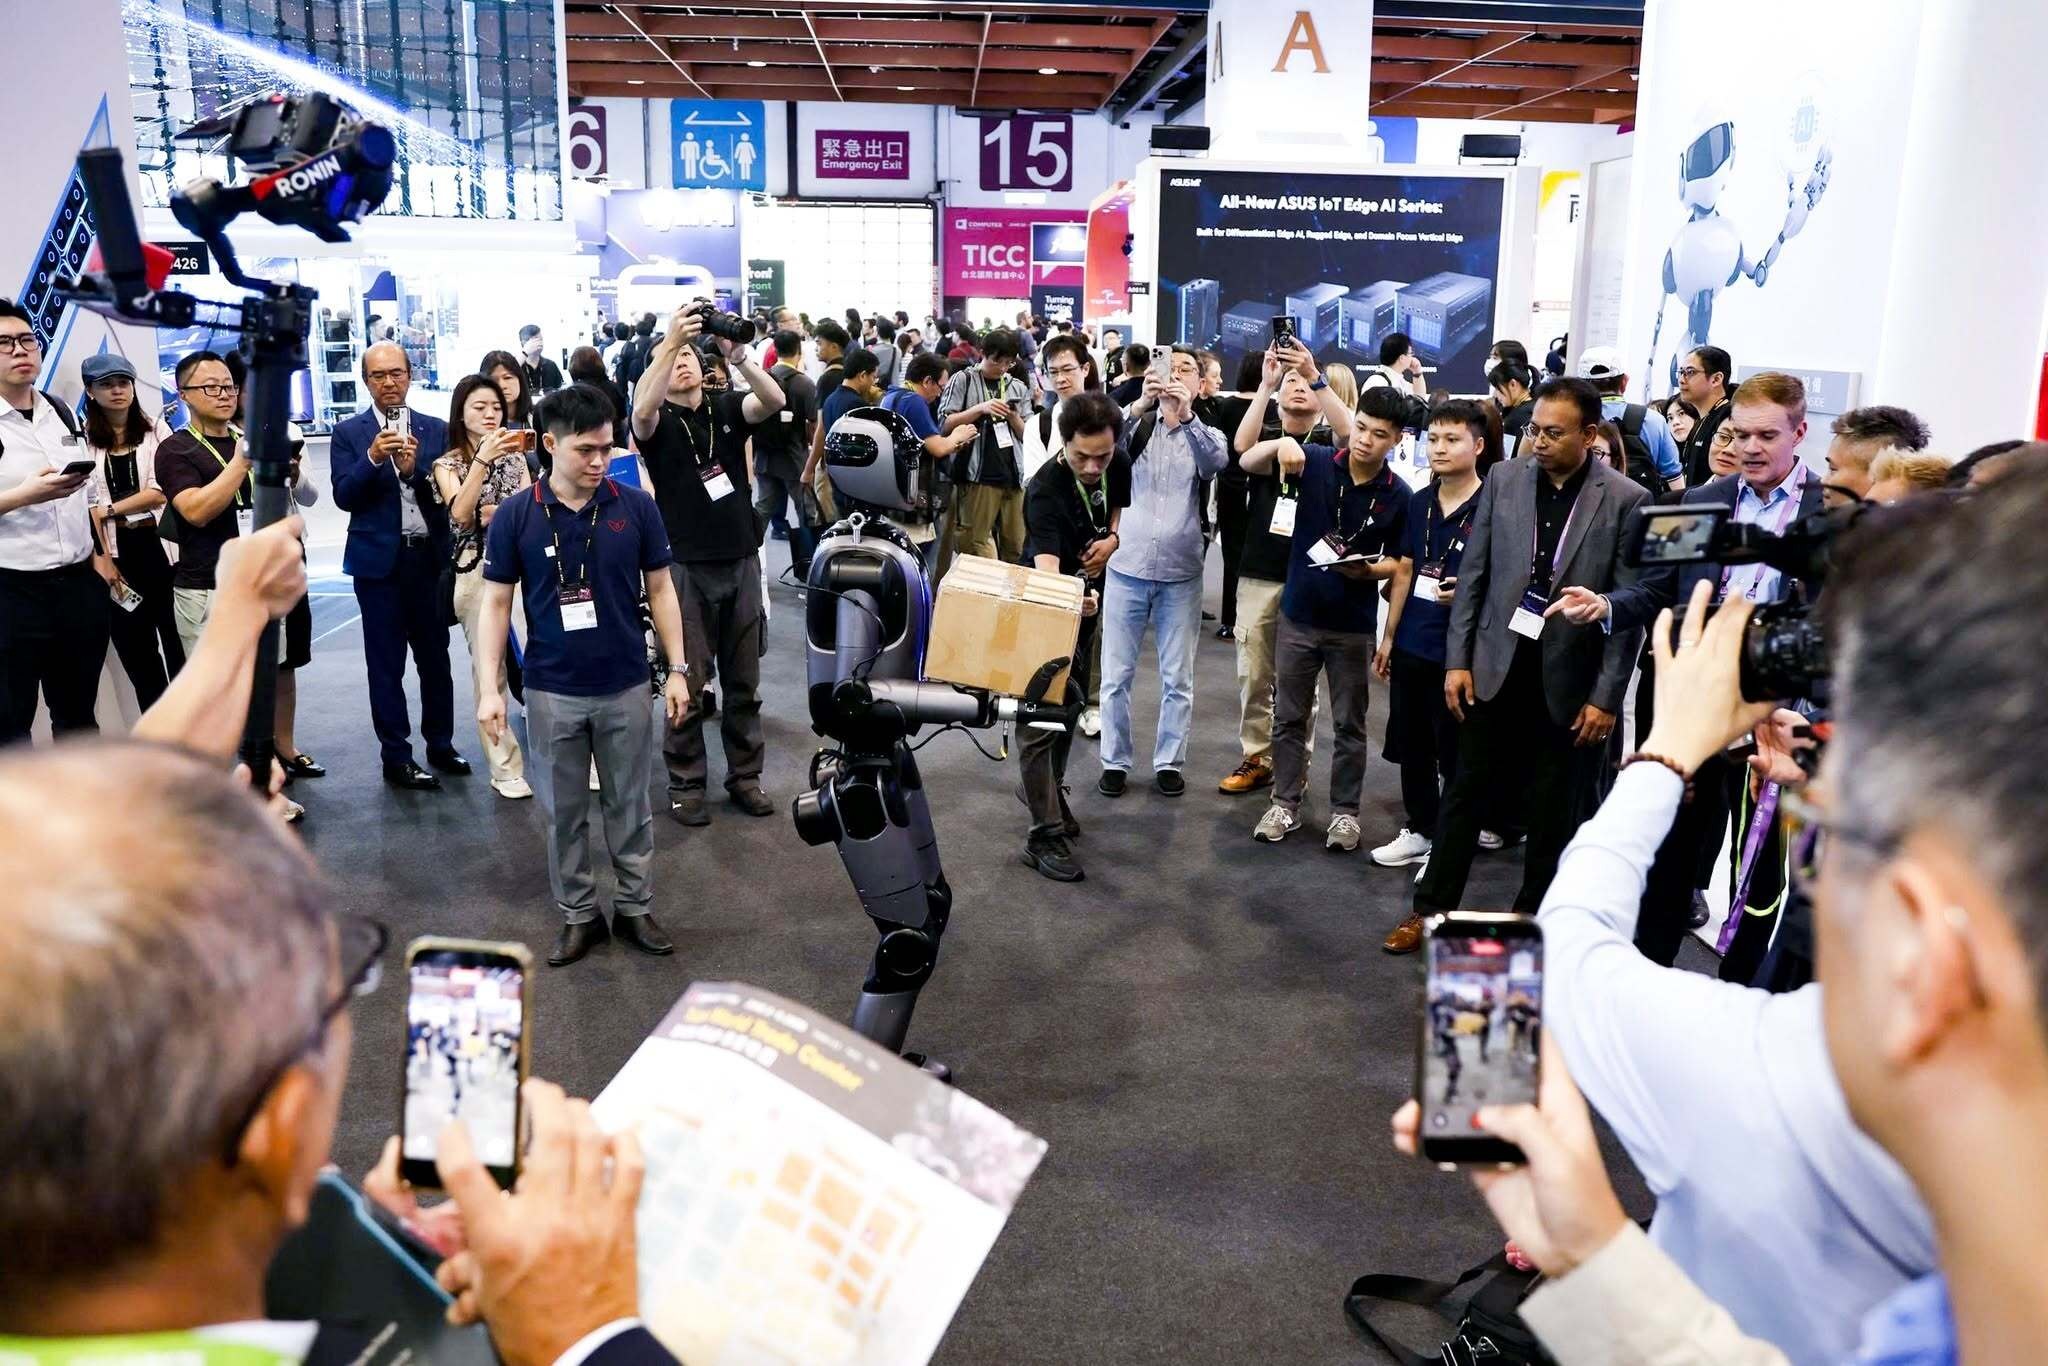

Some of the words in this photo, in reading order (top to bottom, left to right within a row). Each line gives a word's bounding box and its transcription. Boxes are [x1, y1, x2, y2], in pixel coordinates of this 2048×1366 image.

[1271, 10, 1331, 74] A
[569, 111, 602, 177] 6
[822, 138, 903, 159] 緊急出口
[984, 119, 1068, 187] 15
[822, 159, 879, 171] Emergency
[882, 160, 903, 170] Exit
[275, 155, 341, 198] RONIN
[1219, 195, 1277, 209] All-New
[1277, 196, 1317, 210] ASUS
[1319, 197, 1342, 211] IoT
[1343, 197, 1379, 215] Edge
[1380, 199, 1396, 212] AI
[1398, 199, 1443, 214] Series:
[1196, 228, 1213, 236] Built
[1214, 228, 1225, 236] for
[1277, 229, 1294, 239] Edge
[1306, 230, 1333, 240] Rugged
[1354, 231, 1367, 240] and
[1418, 232, 1445, 242] Vertical
[1445, 233, 1463, 243] Edge
[170, 257, 198, 270] 426
[961, 244, 1025, 268] TICC
[750, 267, 774, 280] ront
[1045, 295, 1074, 305] Turning
[1045, 304, 1072, 312] Motion
